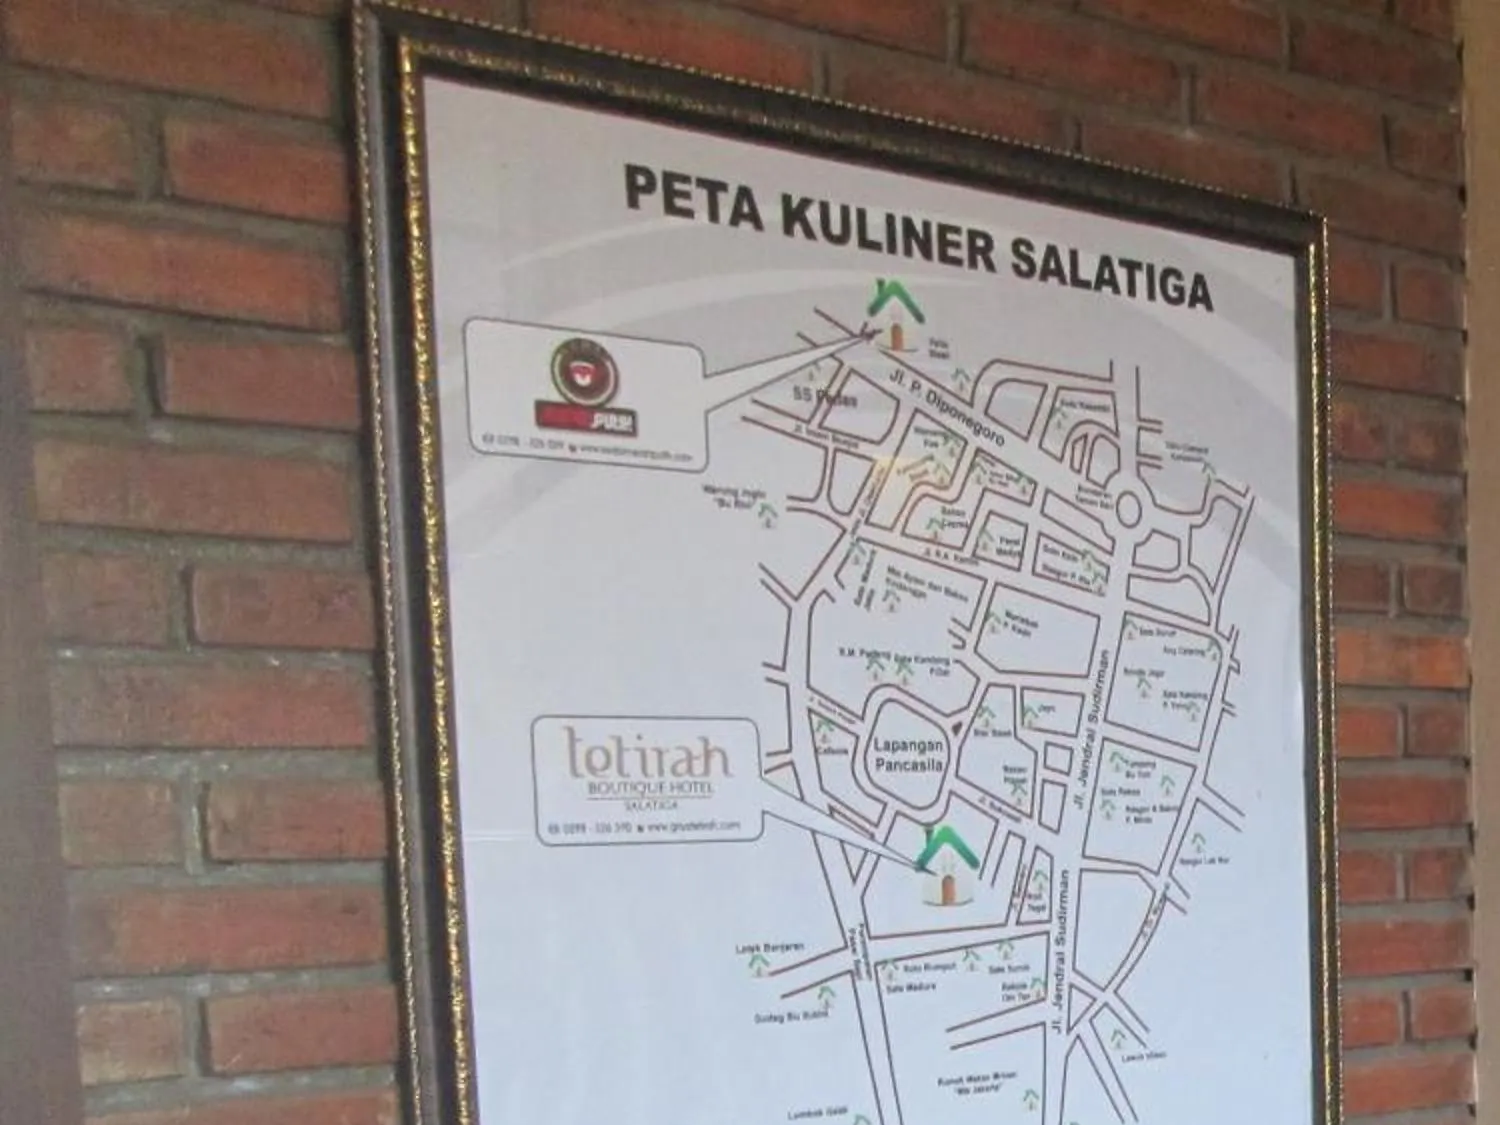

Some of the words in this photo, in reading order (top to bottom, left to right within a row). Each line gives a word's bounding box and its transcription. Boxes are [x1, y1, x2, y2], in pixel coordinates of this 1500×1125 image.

[624, 163, 765, 232] PETA
[782, 193, 997, 273] KULINER
[1011, 237, 1215, 313] SALATIGA
[909, 381, 924, 398] P.
[925, 389, 1006, 448] Diponegoro
[1087, 649, 1110, 724] Sudirman
[873, 737, 944, 755] Lapangan
[875, 756, 944, 773] Pancasila
[1079, 729, 1097, 786] Jendral
[588, 781, 665, 798] BOUTIQUE
[669, 781, 715, 794] HOTEL
[1055, 869, 1070, 947] Sudirman
[1053, 948, 1067, 1011] Jendral
